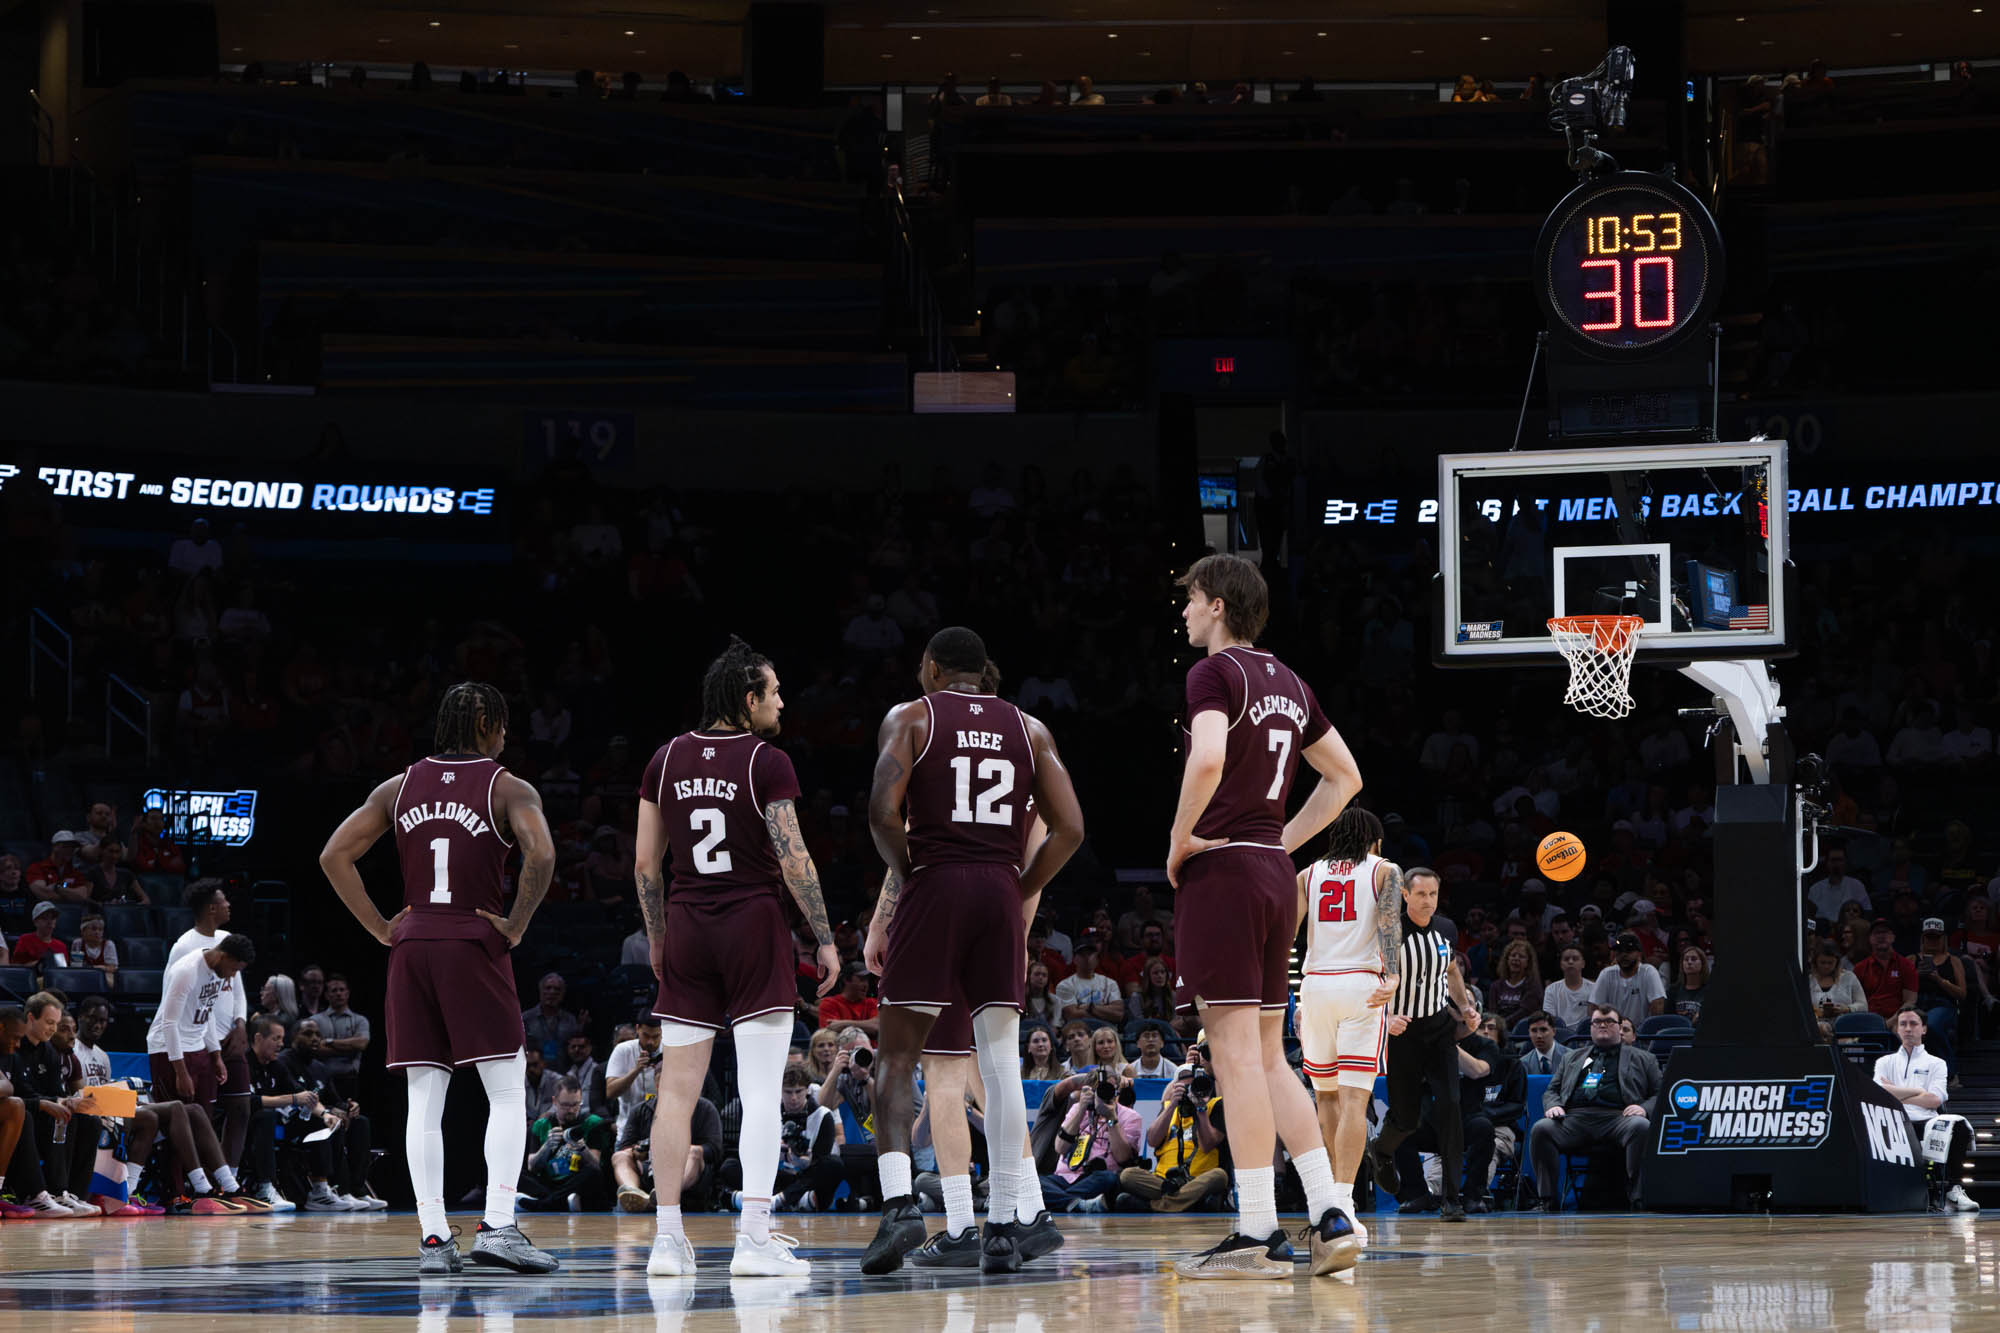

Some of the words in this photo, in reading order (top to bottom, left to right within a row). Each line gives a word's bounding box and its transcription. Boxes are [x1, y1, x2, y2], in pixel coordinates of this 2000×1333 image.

[1588, 212, 1682, 254] 10:53
[1581, 256, 1675, 331] 30
[38, 467, 135, 500] FIRST
[139, 483, 164, 496] AND
[170, 476, 304, 510] SECOND
[311, 483, 455, 514] ROUNDS
[1418, 499, 1502, 523] 26
[1466, 623, 1490, 632] MARCH
[1469, 630, 1501, 639] MADNESS
[956, 730, 1003, 752] AGEE
[1266, 728, 1293, 801] 7
[673, 777, 738, 801] ISAACS
[950, 755, 1015, 826] 12
[398, 801, 490, 837] HOLLOWAY
[689, 808, 733, 875] 2
[1546, 846, 1578, 864] Wilson
[429, 837, 452, 904] 1
[1318, 879, 1357, 922] 21
[1699, 1085, 1786, 1112] MARCH
[1708, 1111, 1828, 1138] MADNESS
[1860, 1101, 1916, 1168] NCAA
